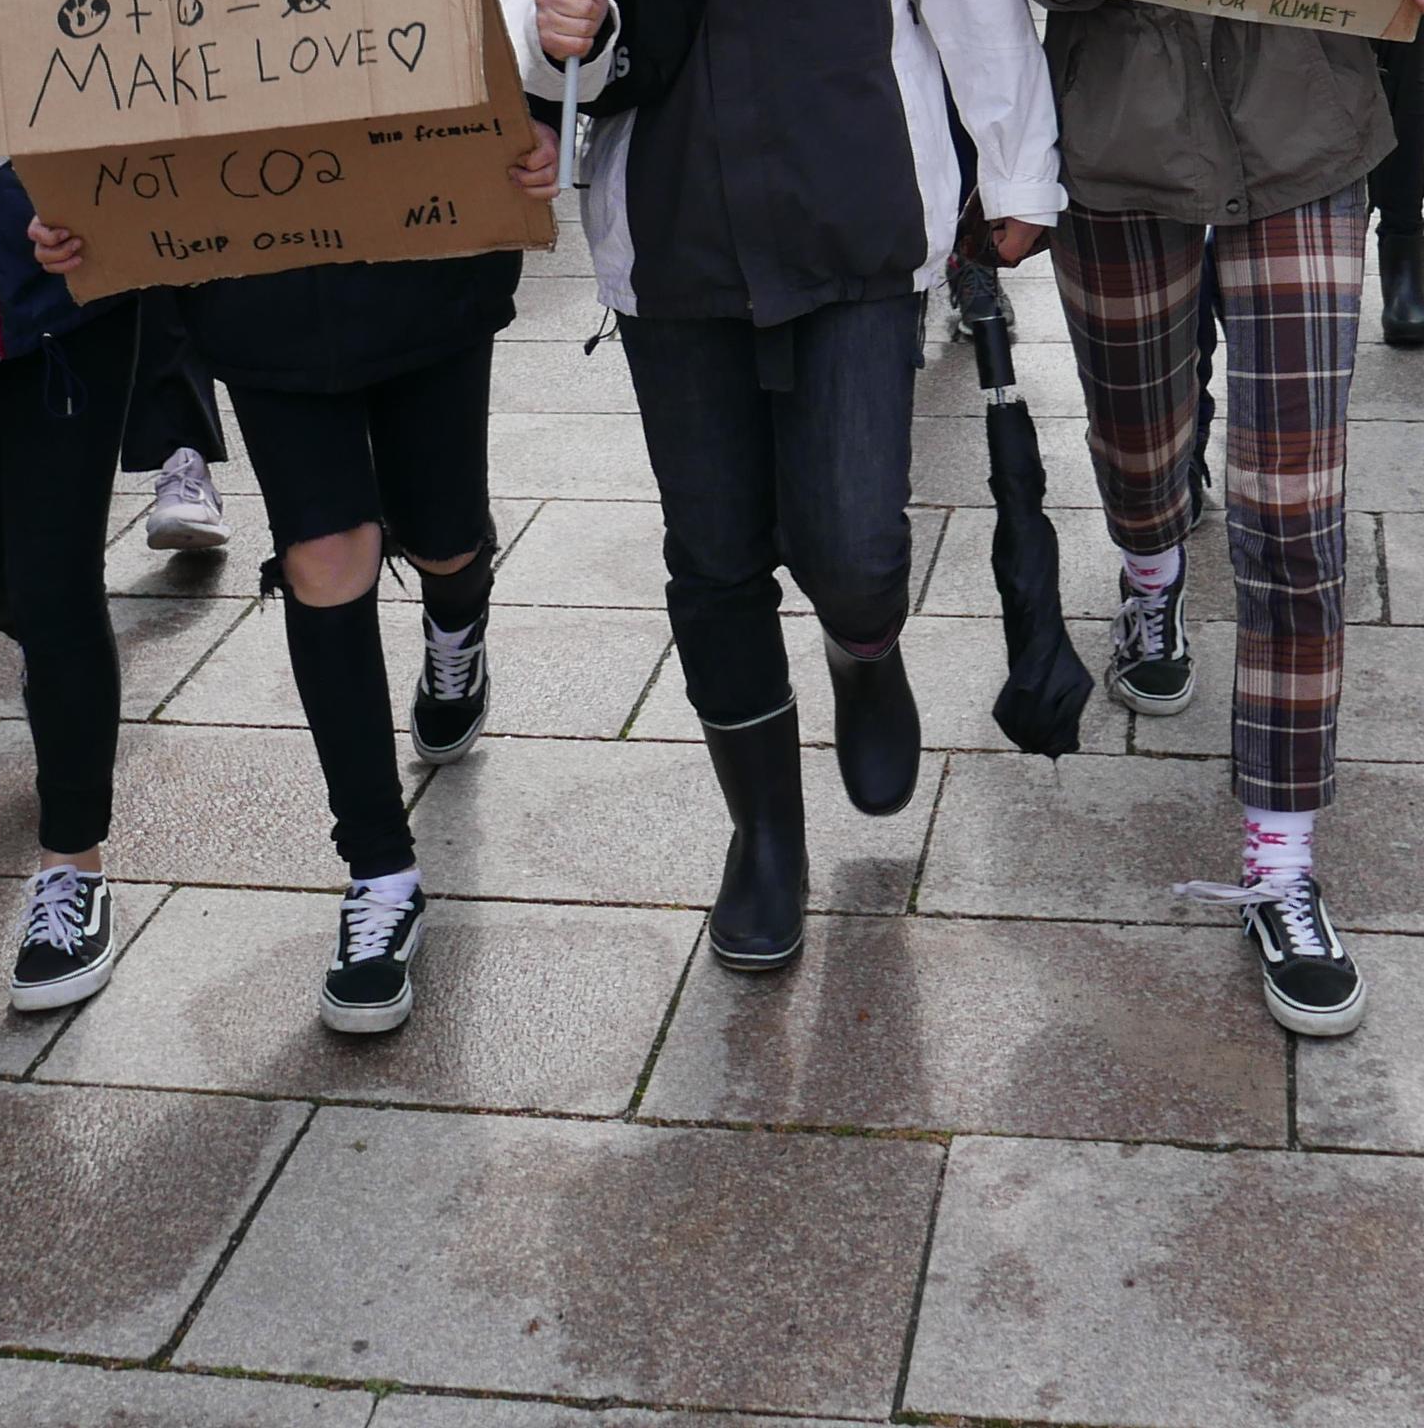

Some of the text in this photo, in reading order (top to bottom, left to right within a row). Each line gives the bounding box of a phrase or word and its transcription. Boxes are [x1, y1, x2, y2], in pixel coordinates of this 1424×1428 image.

[29, 29, 378, 127] MAKE LOVE
[220, 149, 345, 198] CO2
[405, 195, 458, 228] NÅ!
[150, 229, 230, 260] Hjelp
